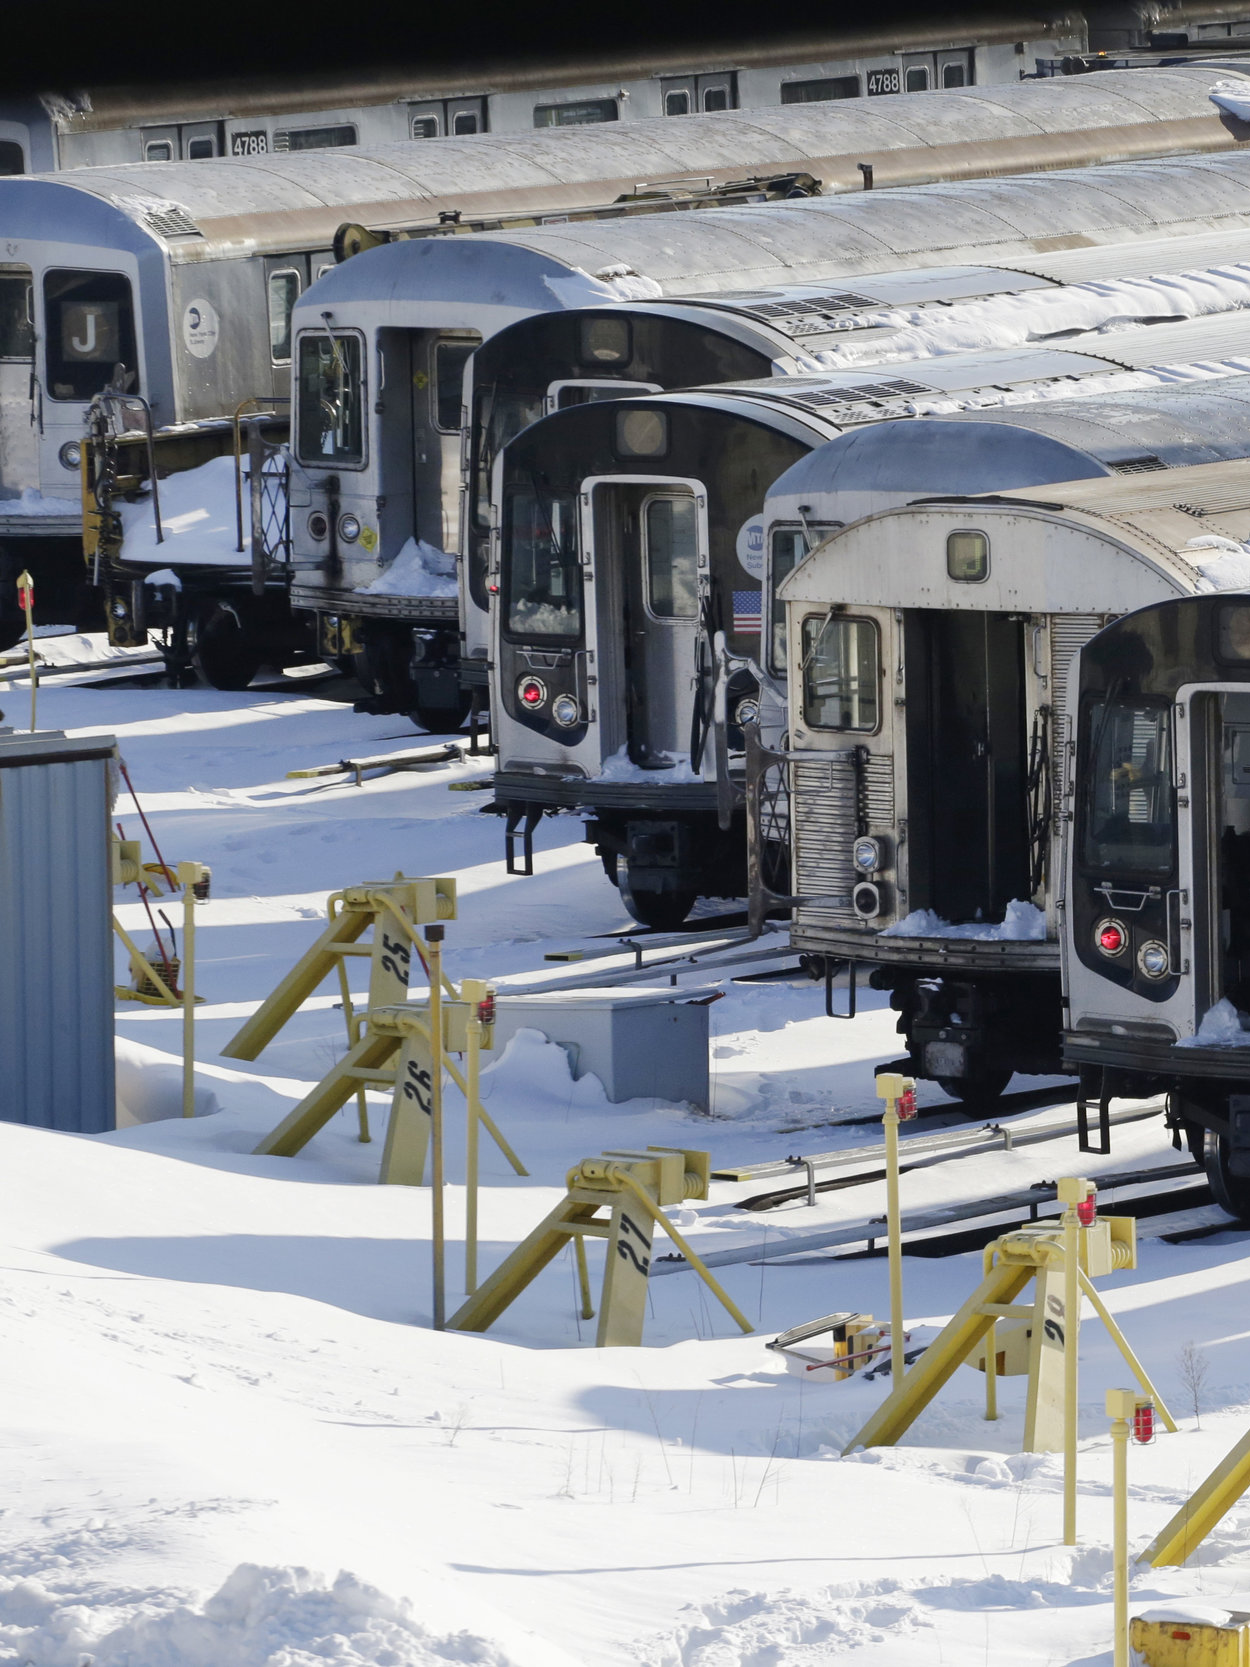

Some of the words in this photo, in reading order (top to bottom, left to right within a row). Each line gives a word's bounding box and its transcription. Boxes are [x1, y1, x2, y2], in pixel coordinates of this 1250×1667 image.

[869, 73, 900, 93] 4788
[234, 135, 267, 156] 4788
[72, 314, 96, 352] J
[381, 933, 410, 986] 25
[403, 1060, 432, 1116] 26
[617, 1212, 651, 1277] 27
